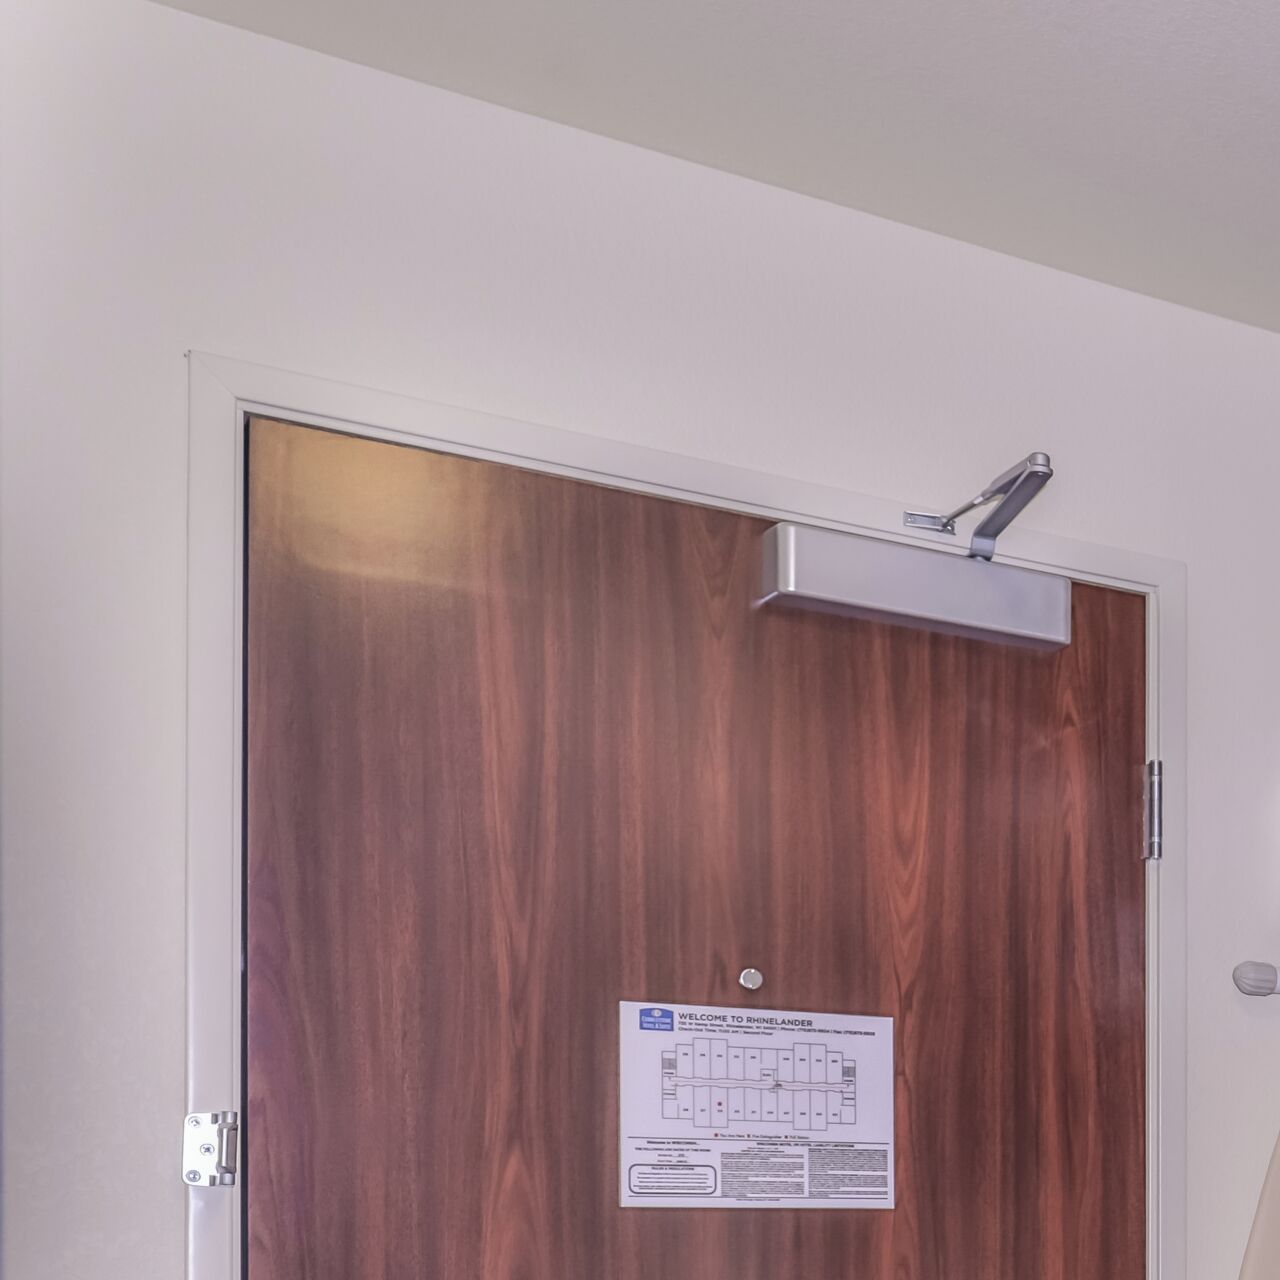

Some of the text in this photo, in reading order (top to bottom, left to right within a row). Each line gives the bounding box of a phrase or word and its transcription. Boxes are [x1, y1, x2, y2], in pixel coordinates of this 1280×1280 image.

[678, 1012, 813, 1027] WELCOME TO RHINELANDER
